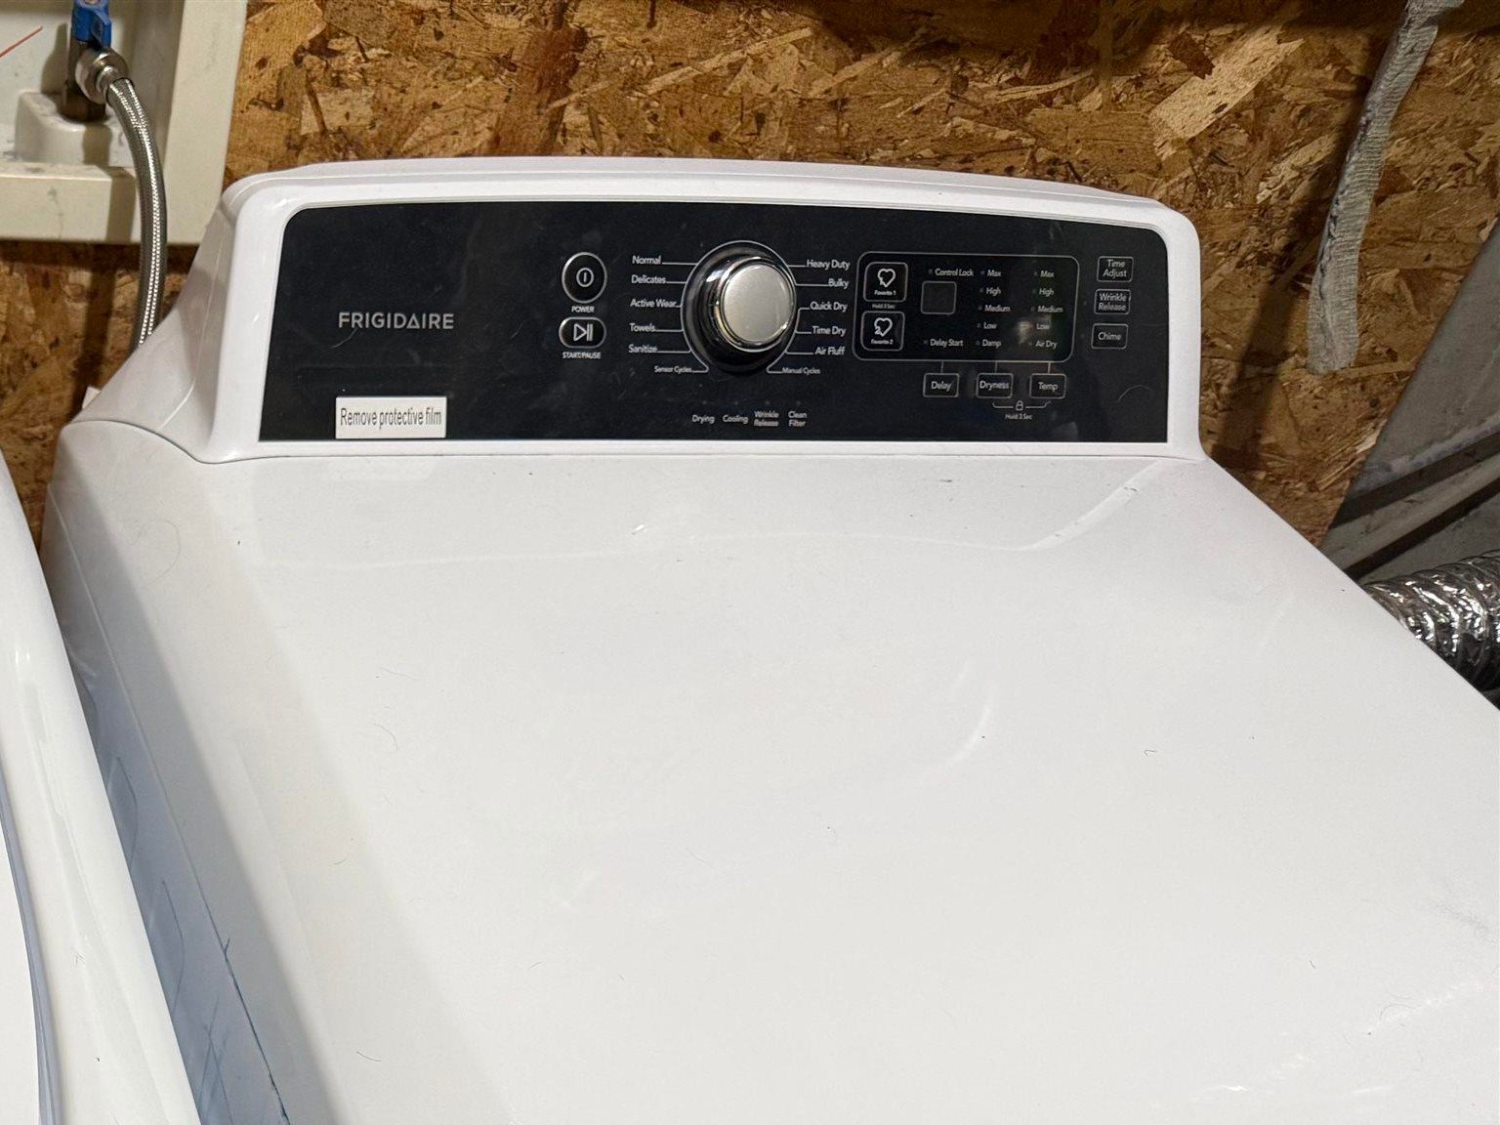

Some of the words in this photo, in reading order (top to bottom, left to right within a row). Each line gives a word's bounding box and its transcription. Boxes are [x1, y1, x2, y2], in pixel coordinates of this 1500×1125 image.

[632, 256, 661, 265] Normal
[806, 260, 830, 270] Heavy
[831, 260, 850, 270] Duty
[1107, 259, 1125, 267] Time
[934, 268, 958, 276] Control
[987, 269, 1001, 277] Max
[1040, 270, 1054, 278] Max
[1102, 269, 1127, 279] Adjust
[631, 275, 666, 284] Delicates
[828, 278, 849, 289] Bulky
[986, 287, 1001, 297] High
[1039, 287, 1054, 297] High
[1100, 293, 1126, 302] Wrinkle
[630, 299, 654, 308] Active
[655, 299, 676, 308] Wear
[810, 302, 832, 311] Quick
[833, 302, 848, 312] Dry
[1098, 302, 1126, 311] Release
[1038, 305, 1063, 313] Medium
[339, 312, 454, 329] FRIGIDAIRE
[629, 323, 655, 332] Towels
[812, 326, 831, 334] Time
[832, 326, 846, 337] Dry
[1098, 332, 1121, 341] Chime
[930, 338, 948, 348] Delay
[948, 339, 963, 347] Start
[982, 339, 1001, 348] Damp
[1045, 340, 1058, 349] Dry
[628, 344, 658, 353] Sanitize
[815, 347, 827, 355] Air
[828, 346, 845, 355] Fluff
[674, 366, 692, 374] Cycles
[803, 367, 820, 375] Cycles
[931, 381, 951, 391] Delay
[980, 380, 1009, 390] Dryness
[1038, 382, 1058, 392] Temp
[340, 408, 377, 426] Remove
[379, 408, 423, 430] protective
[425, 407, 442, 425] film
[692, 414, 715, 424] Drying
[722, 415, 749, 424] Cooling
